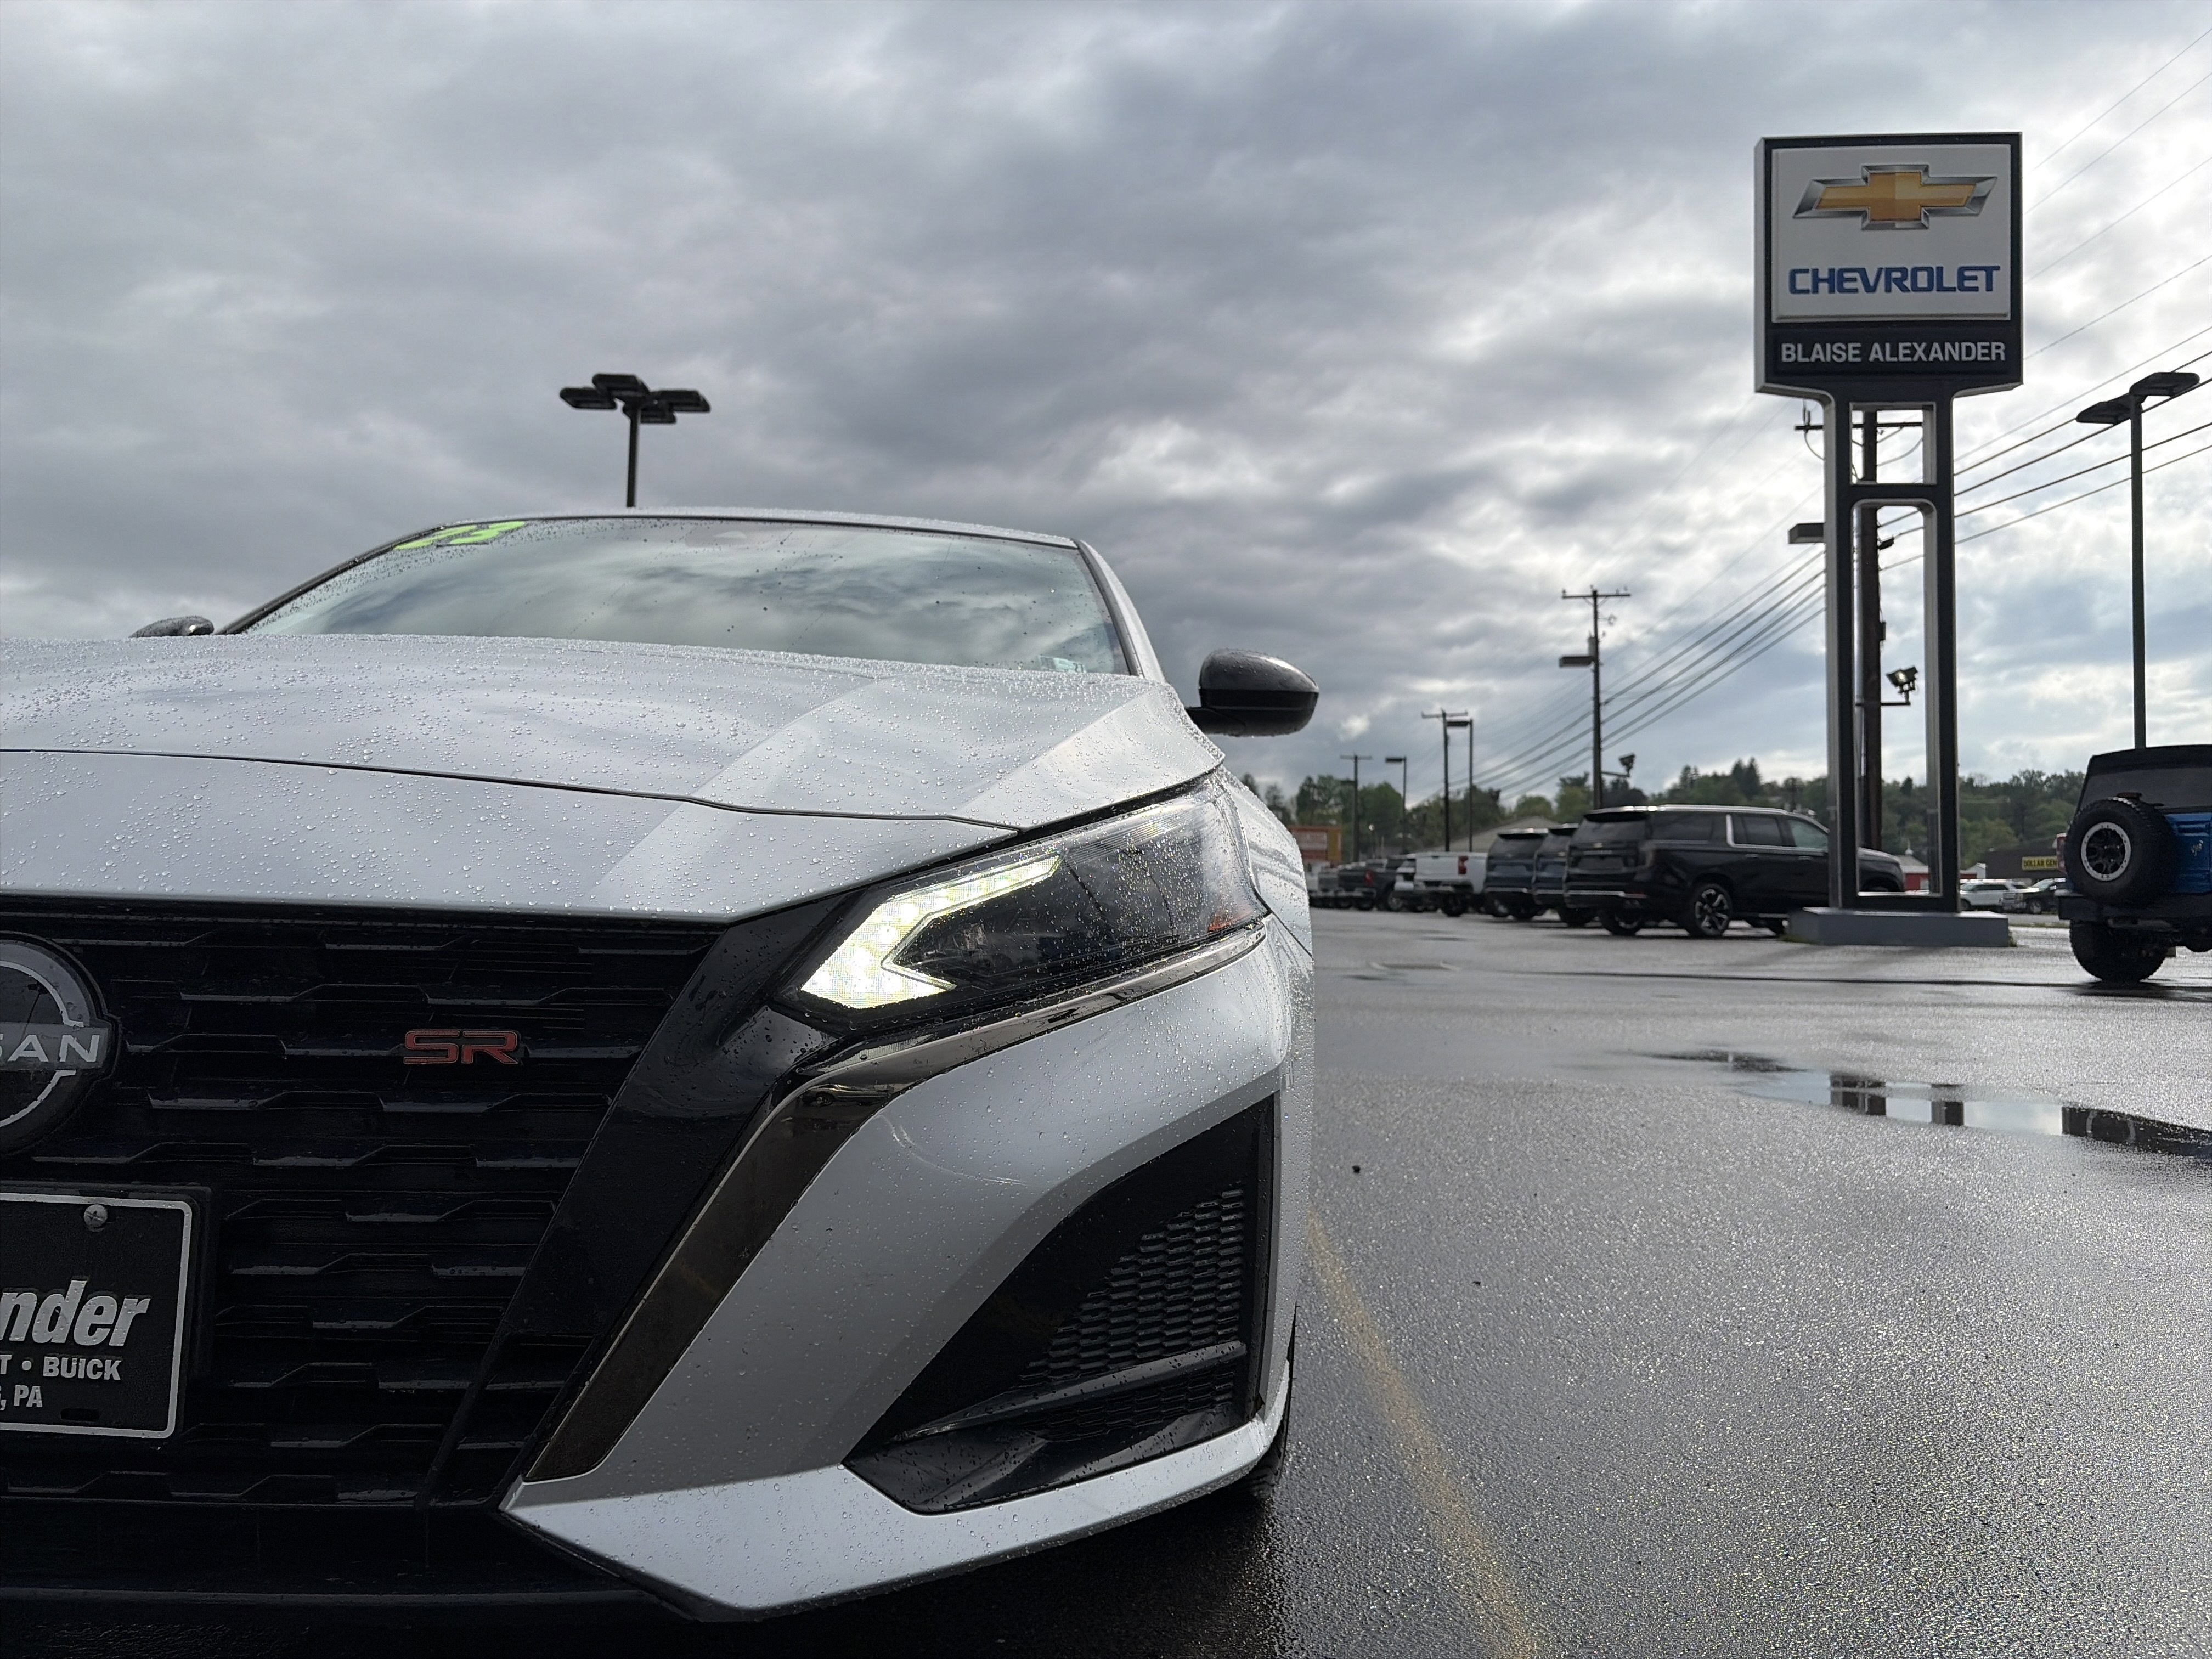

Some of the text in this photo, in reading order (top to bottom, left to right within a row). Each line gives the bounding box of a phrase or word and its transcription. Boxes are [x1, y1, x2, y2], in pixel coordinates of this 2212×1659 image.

[1788, 266, 2001, 294] CHEVROLET
[1781, 341, 2006, 363] BLAISE ALEXANDER
[0, 1034, 100, 1062] AN
[404, 1030, 518, 1064] SR
[43, 1356, 122, 1381] BUICK
[13, 1384, 43, 1408] PA
